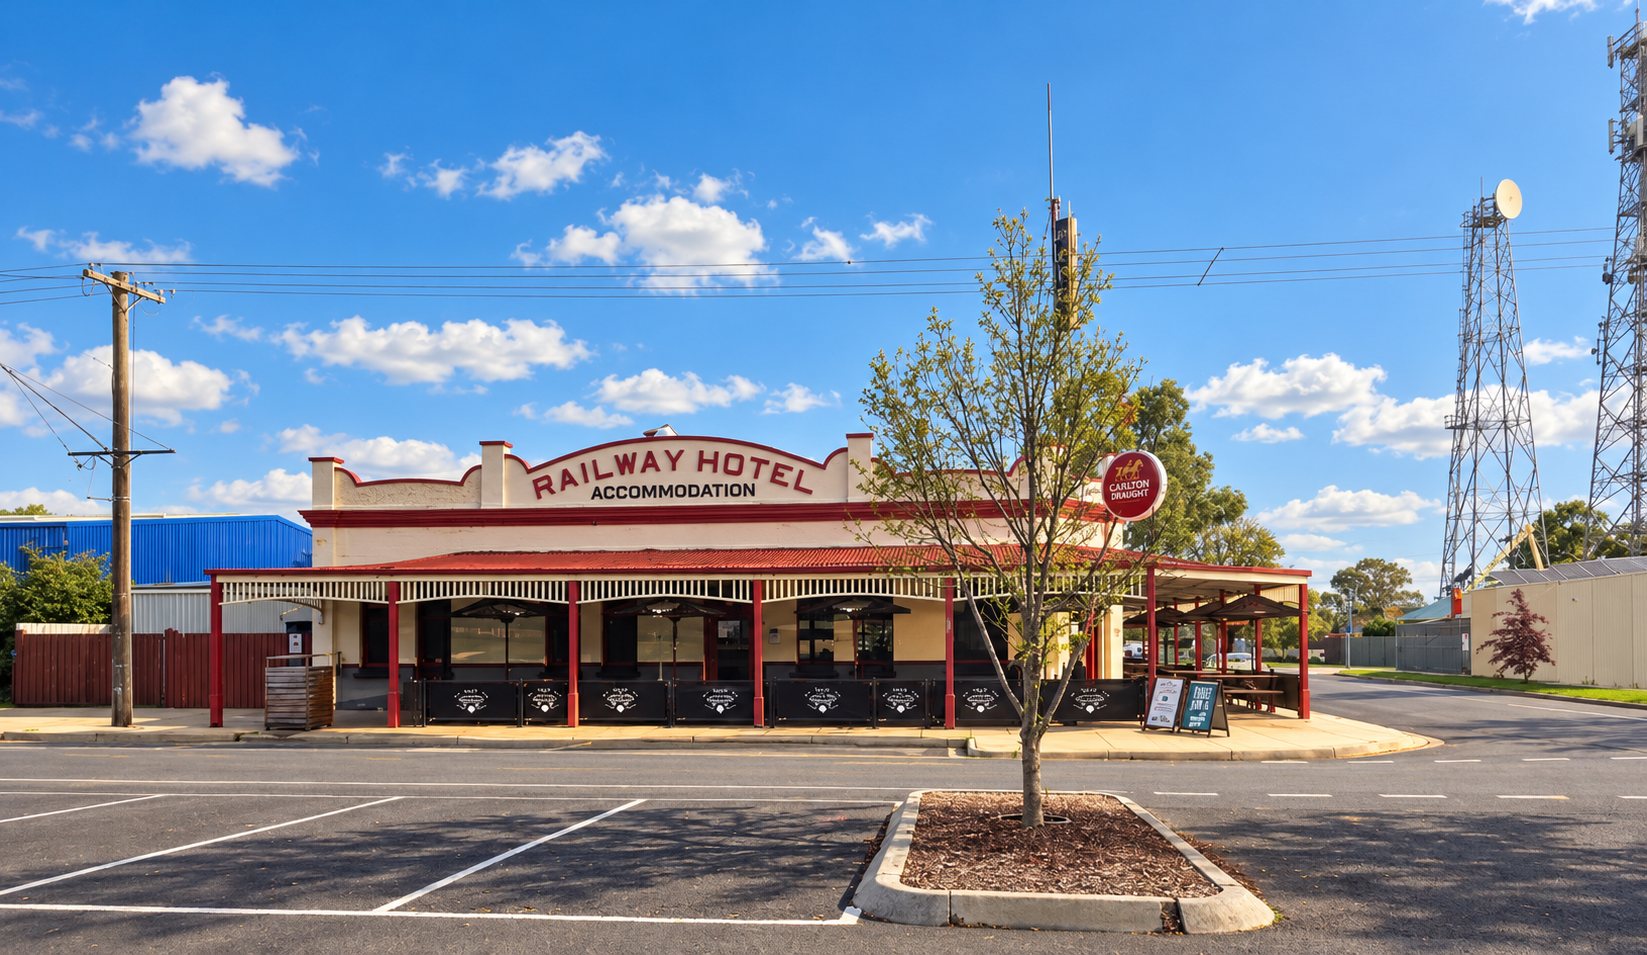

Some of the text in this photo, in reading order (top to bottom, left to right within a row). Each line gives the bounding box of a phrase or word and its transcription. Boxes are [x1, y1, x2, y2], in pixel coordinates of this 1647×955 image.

[532, 450, 813, 500] RAILWAY HOTEL
[591, 483, 756, 500] ACCOMMODATION
[1109, 480, 1150, 492] CARLTON
[1111, 489, 1149, 501] DRAUGHT
